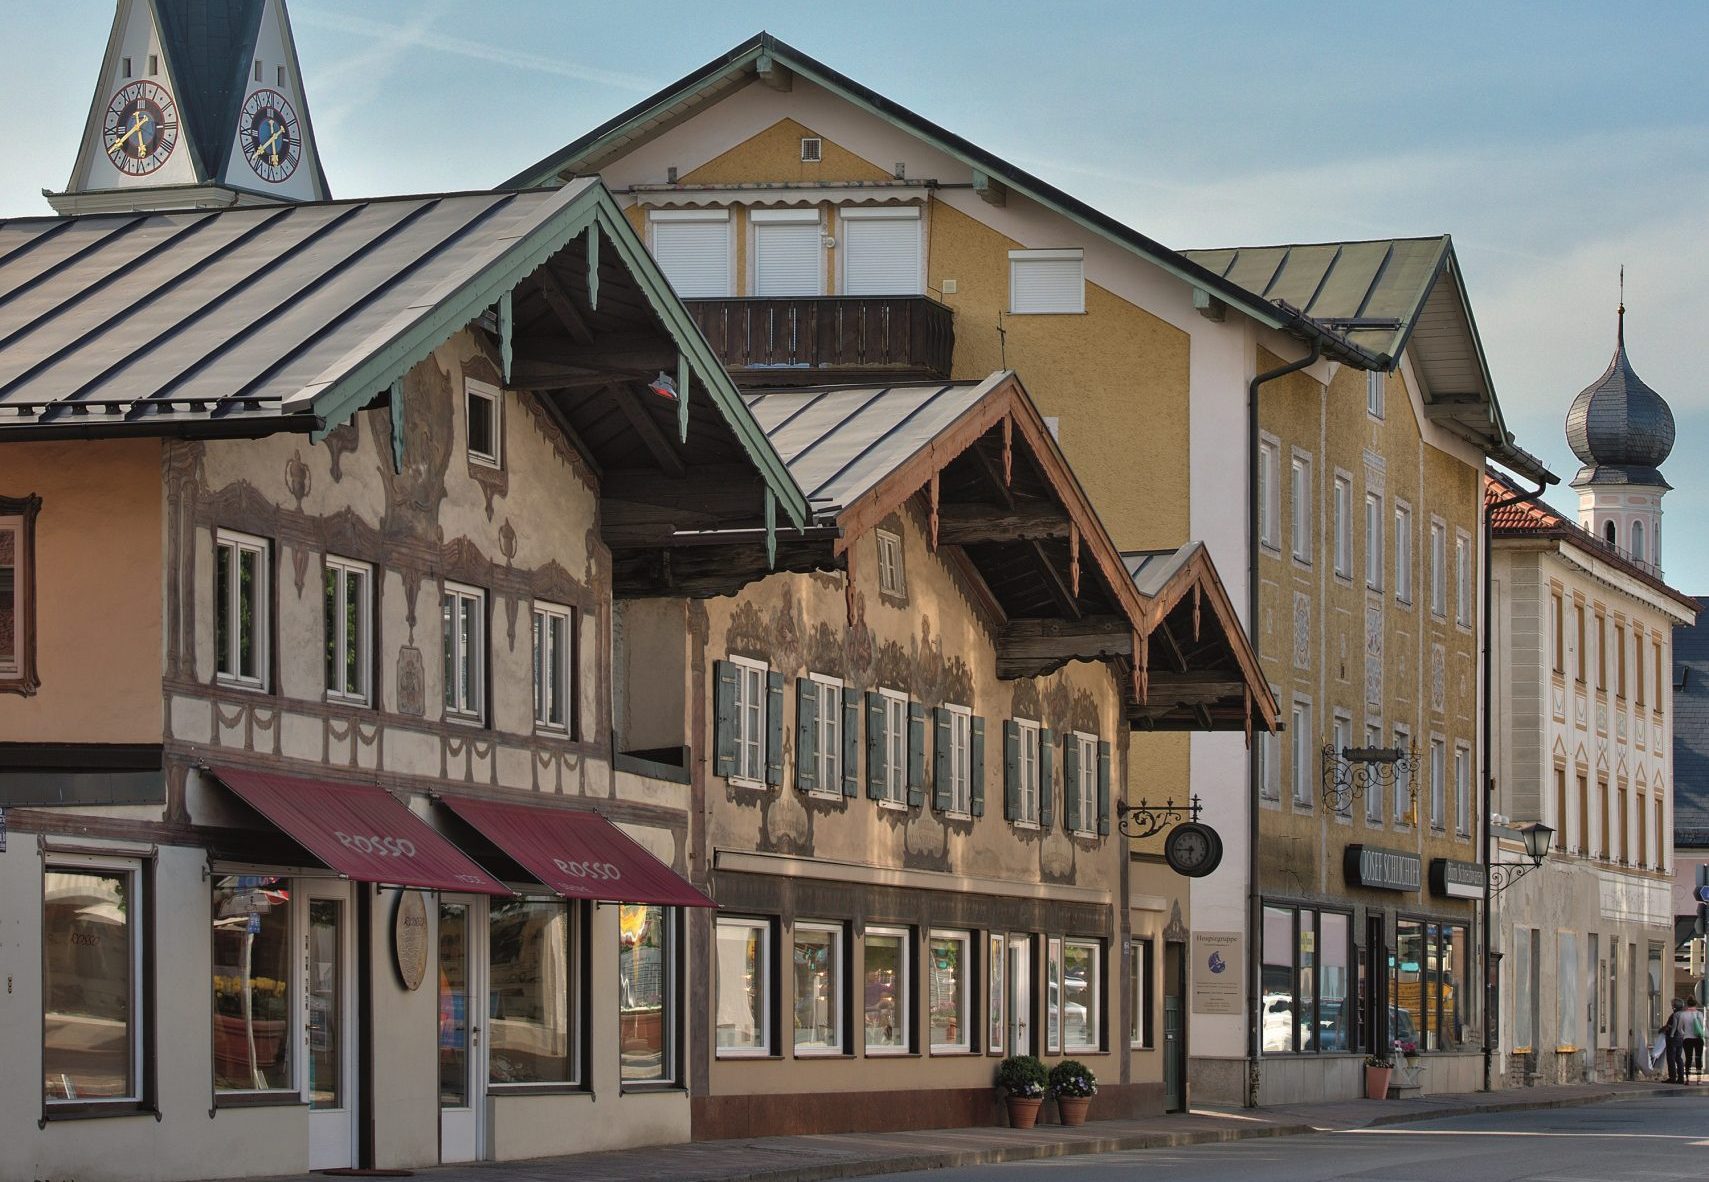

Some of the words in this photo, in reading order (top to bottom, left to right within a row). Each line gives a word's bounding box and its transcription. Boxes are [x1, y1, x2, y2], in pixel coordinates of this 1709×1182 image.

[334, 831, 417, 858] ROSSO
[553, 858, 621, 880] ROSSO
[1362, 850, 1383, 882] JOSEF
